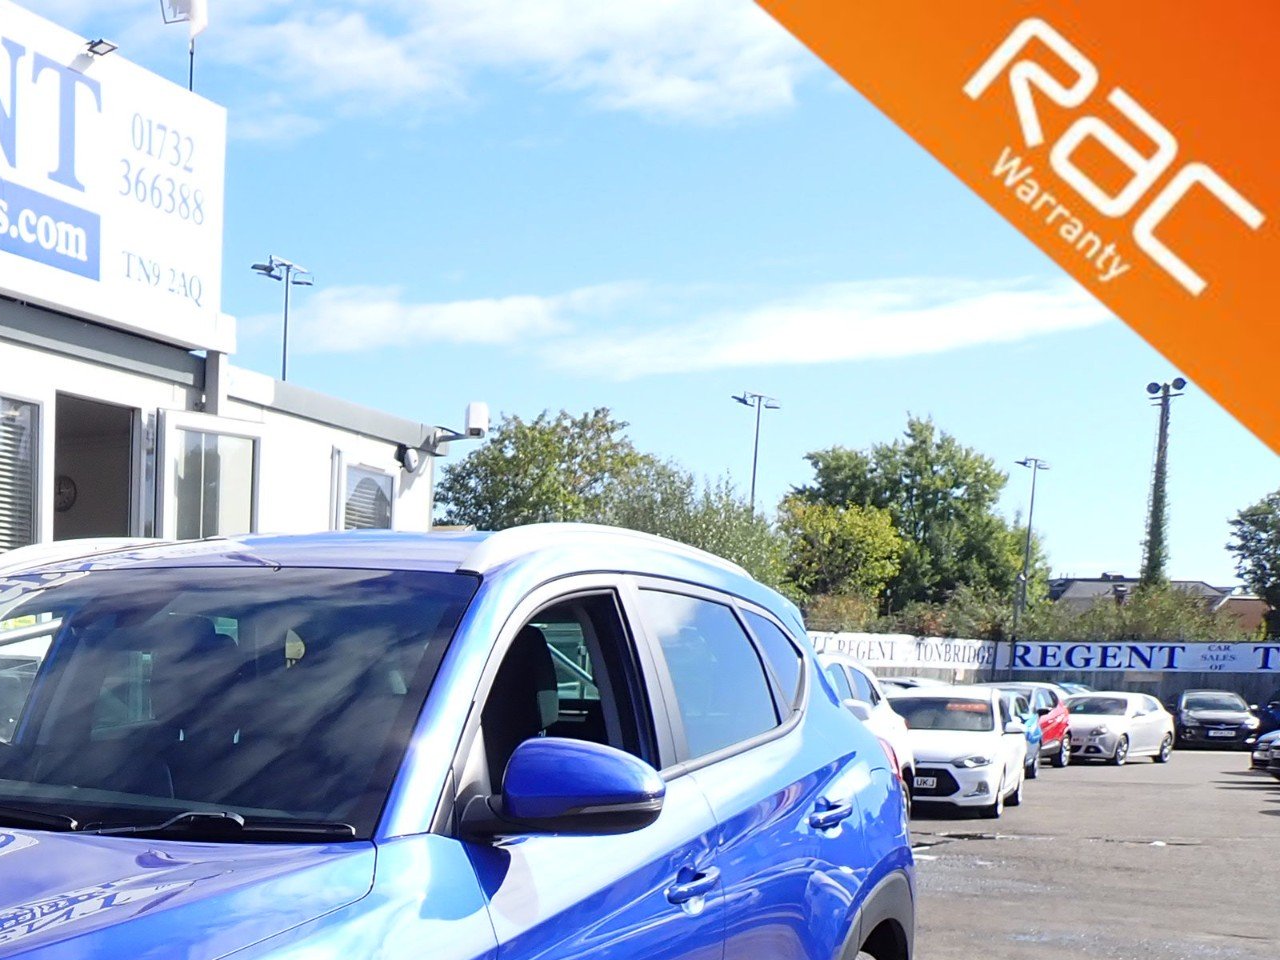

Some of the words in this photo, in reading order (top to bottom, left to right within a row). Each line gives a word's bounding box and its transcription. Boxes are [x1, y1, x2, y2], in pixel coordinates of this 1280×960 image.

[131, 112, 195, 174] 01732
[119, 158, 205, 226] 366388
[122, 250, 161, 287] TN9
[168, 267, 203, 308] 2AQ
[915, 641, 995, 665] TONBRIDGE
[1005, 643, 1186, 671] REGENT
[1200, 653, 1237, 662] SALES
[1207, 644, 1231, 652] CAR
